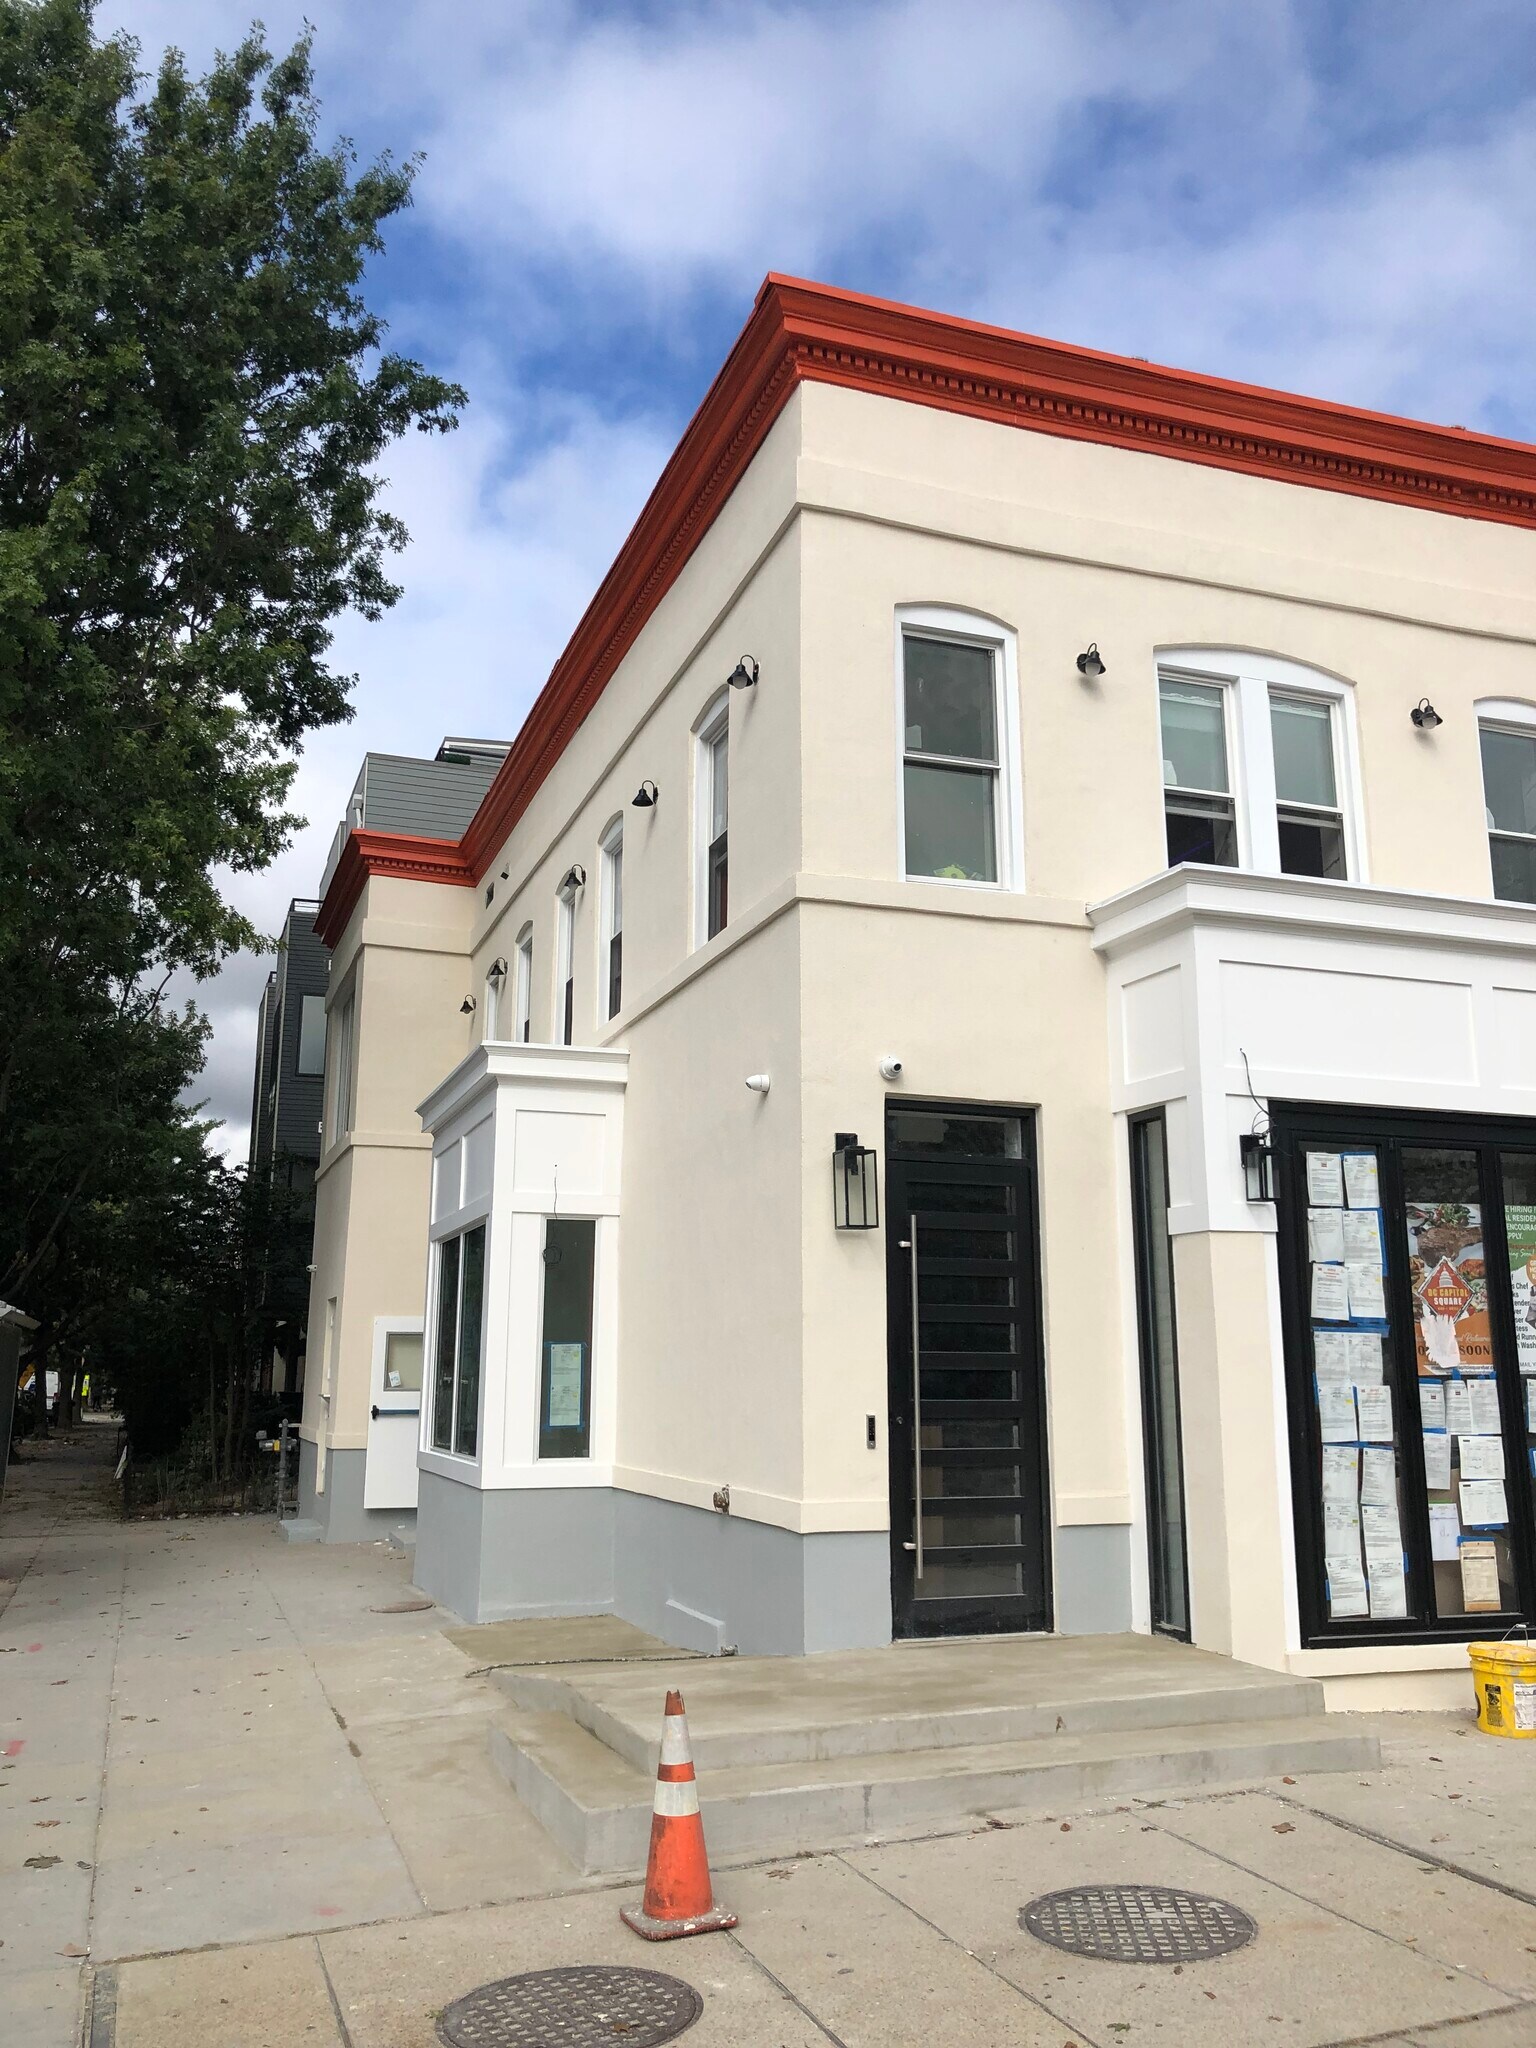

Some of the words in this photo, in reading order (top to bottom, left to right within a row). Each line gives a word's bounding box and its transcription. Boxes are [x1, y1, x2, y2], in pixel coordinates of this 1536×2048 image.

[1440, 1288, 1468, 1297] CAPITOL
[1434, 1297, 1462, 1306] SQUARE
[1460, 1345, 1490, 1356] SOON
